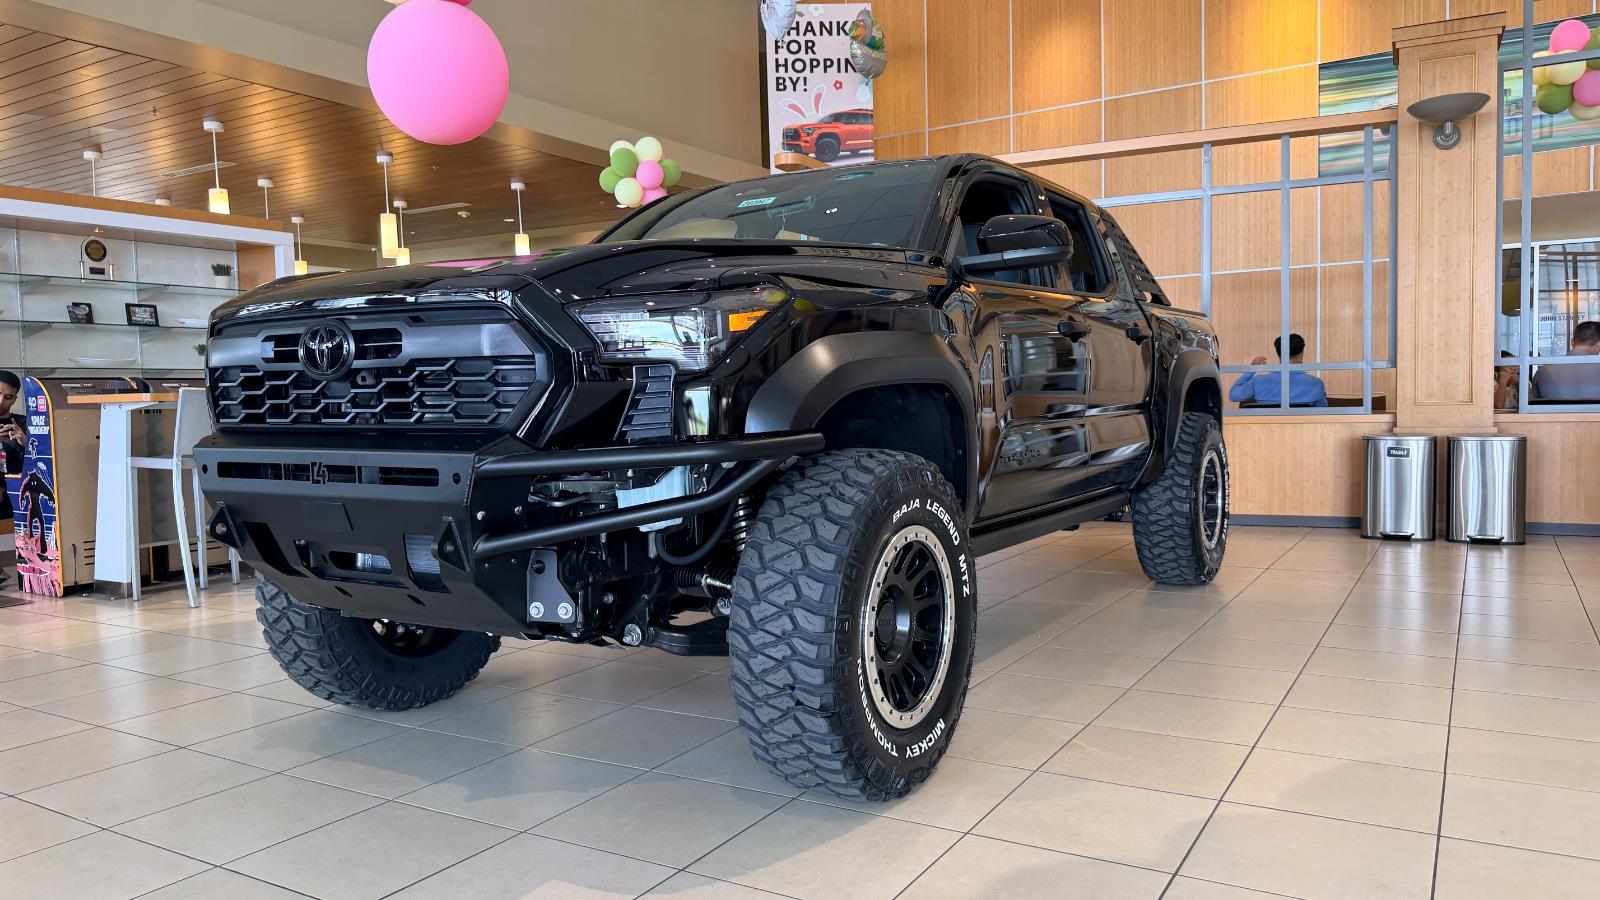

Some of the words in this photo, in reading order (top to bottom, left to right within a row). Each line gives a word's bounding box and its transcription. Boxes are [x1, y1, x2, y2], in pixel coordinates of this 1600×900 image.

[787, 21, 855, 36] HANK
[774, 39, 817, 55] FOR
[775, 76, 808, 92] BY!
[893, 498, 920, 524] BAJA
[926, 499, 960, 546] LEGEND
[959, 553, 970, 598] MTZ
[857, 657, 899, 757] THOMPSON
[905, 718, 946, 759] MICKEY
